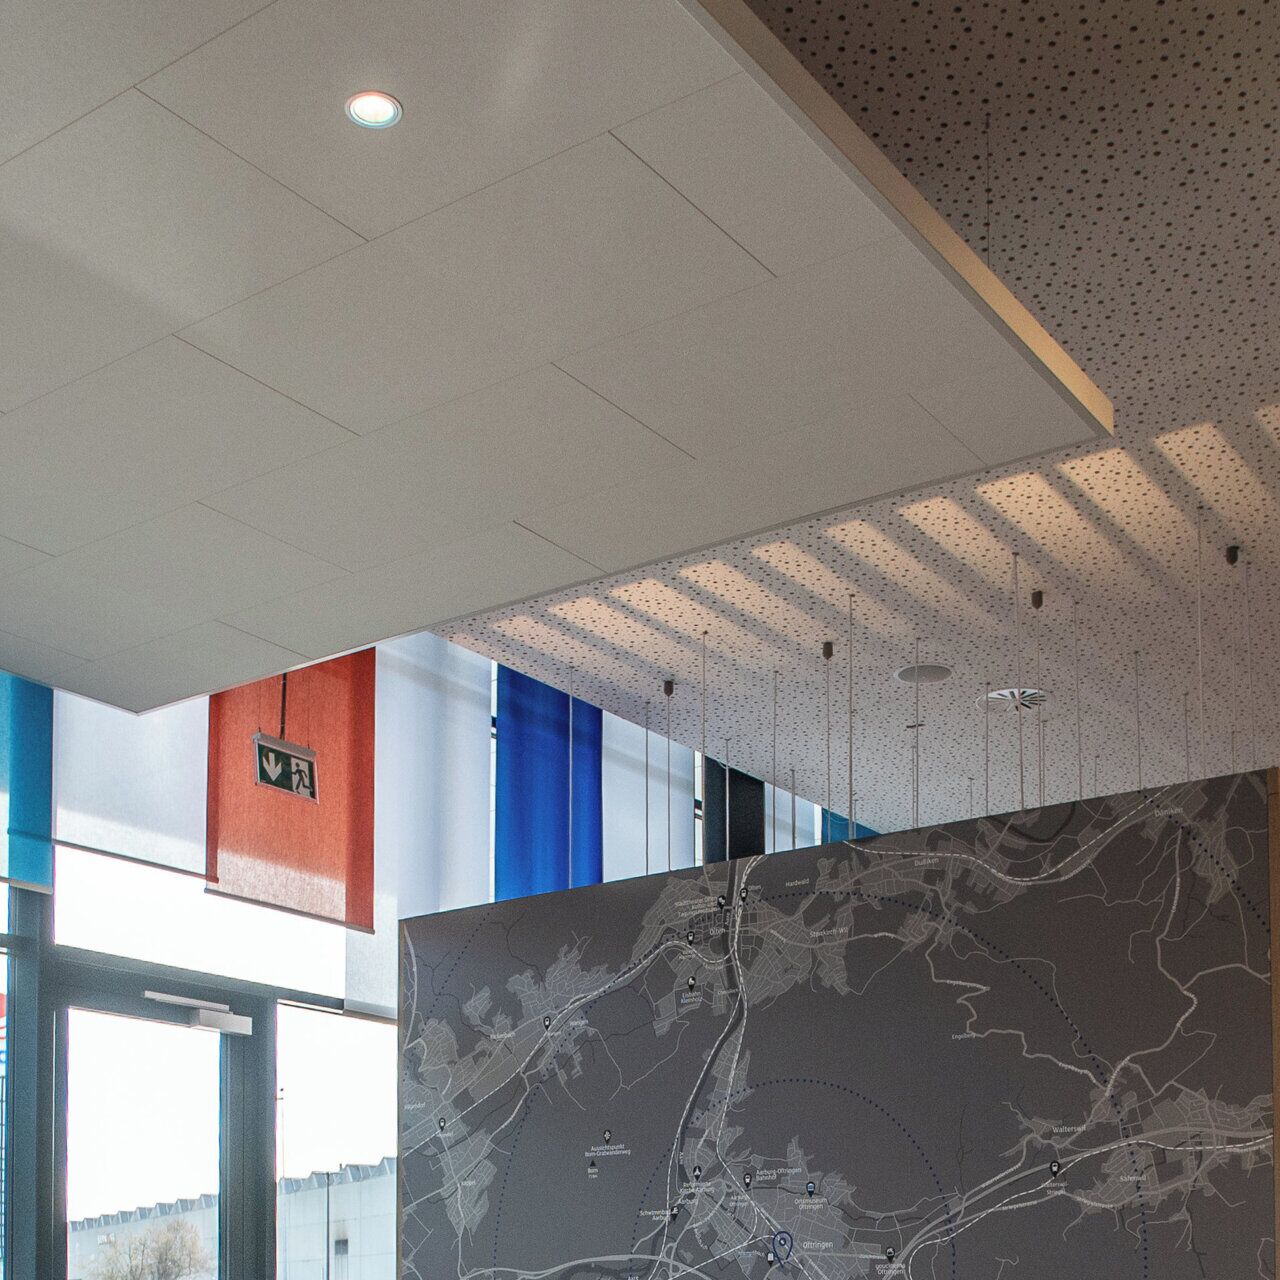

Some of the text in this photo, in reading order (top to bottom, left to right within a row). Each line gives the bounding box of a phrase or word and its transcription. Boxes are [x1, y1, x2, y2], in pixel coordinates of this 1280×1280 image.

[785, 878, 810, 887] Hardwald
[709, 927, 726, 936] Olten
[1052, 1125, 1087, 1134] Walterswil
[802, 1241, 834, 1250] Oftringen
